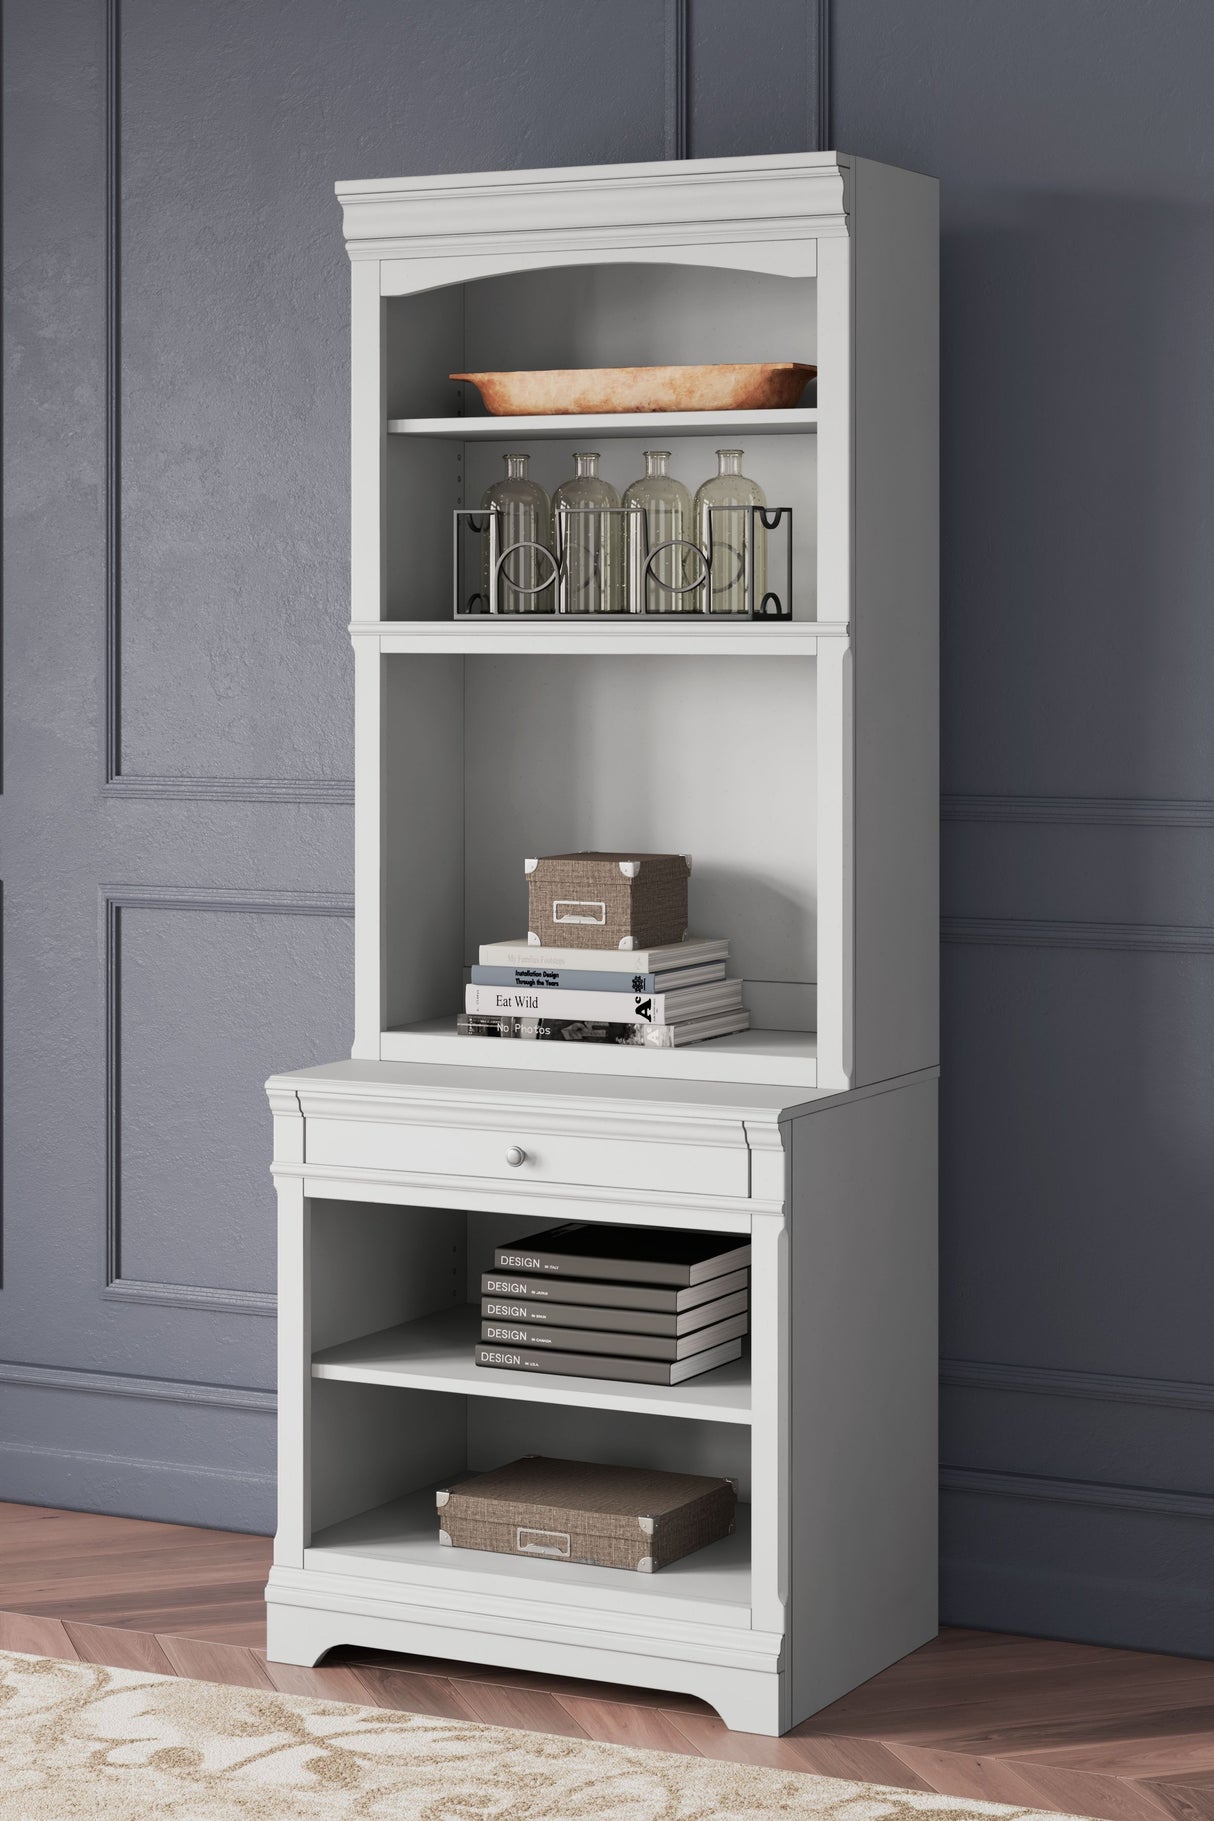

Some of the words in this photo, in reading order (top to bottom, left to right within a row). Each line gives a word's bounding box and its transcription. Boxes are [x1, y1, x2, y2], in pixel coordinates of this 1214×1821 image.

[543, 971, 560, 980] Design
[515, 978, 536, 987] Through
[496, 995, 512, 1007] Eat
[515, 995, 538, 1009] Wild
[496, 1023, 510, 1032] No
[514, 1023, 551, 1035] Photos
[500, 1255, 540, 1268] DESIGN
[487, 1281, 527, 1294] DESIGN
[487, 1304, 527, 1317] DESIGN
[487, 1328, 527, 1341] DESIGN
[481, 1351, 521, 1365] DESIGN
